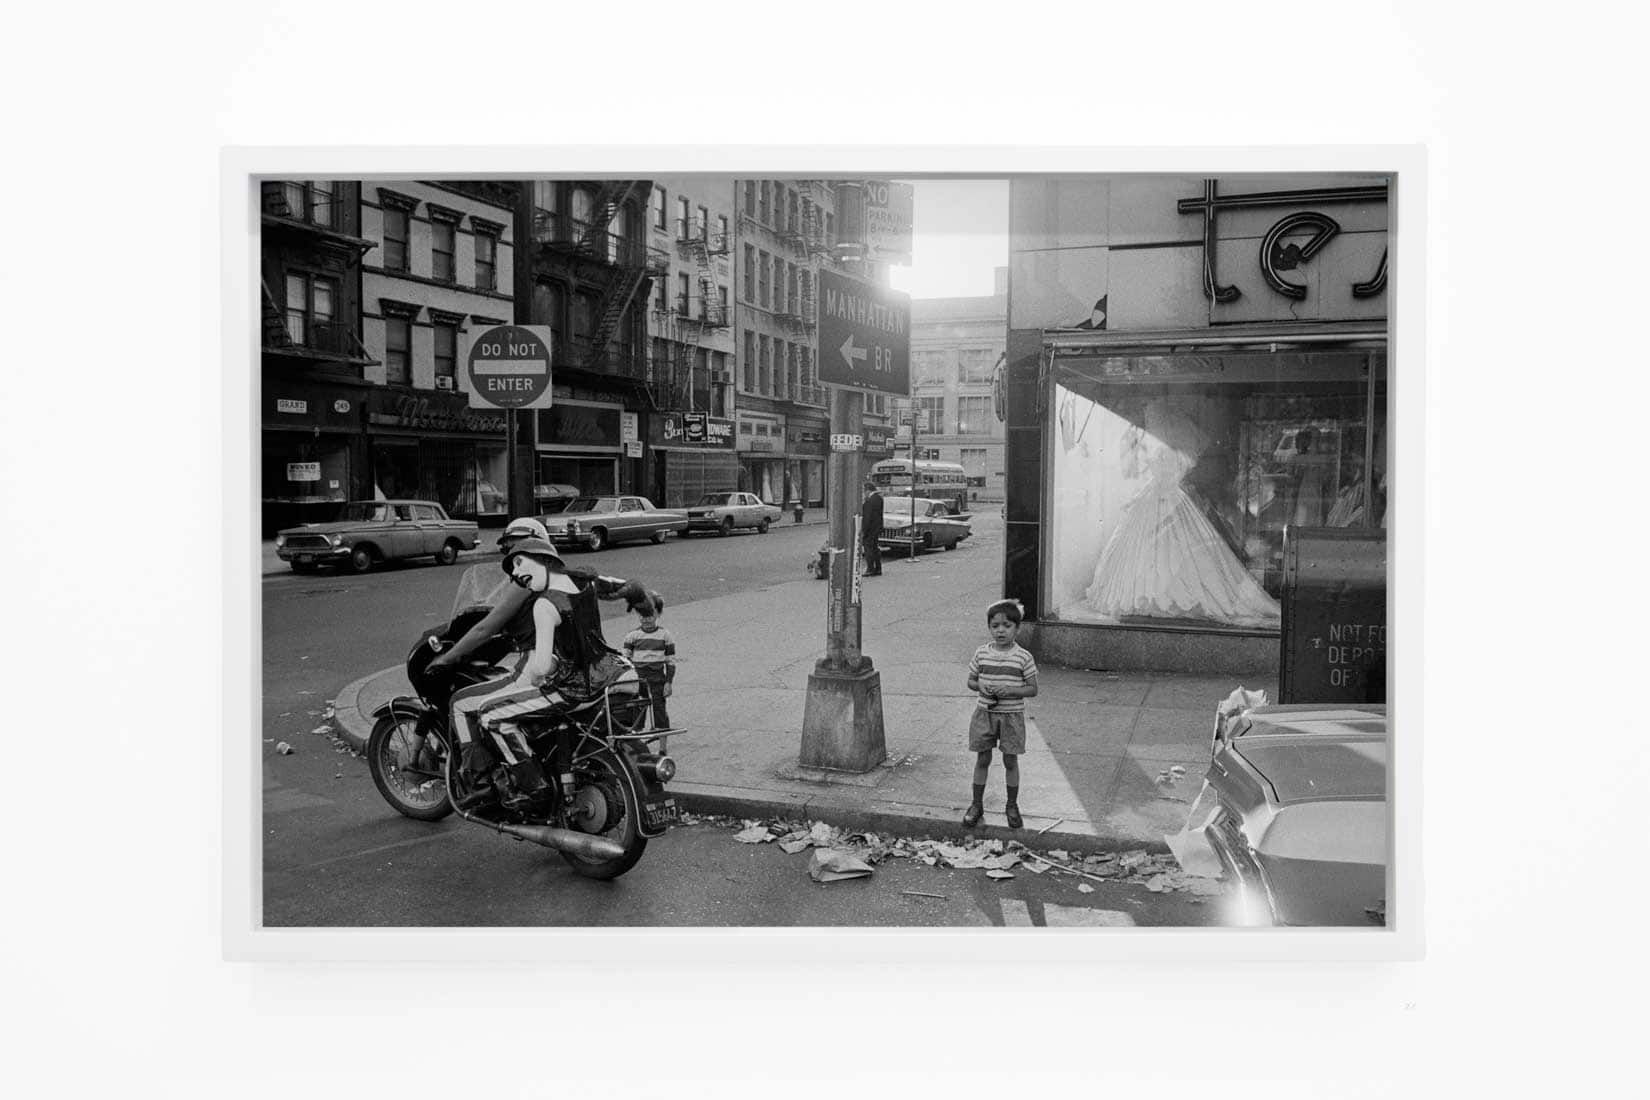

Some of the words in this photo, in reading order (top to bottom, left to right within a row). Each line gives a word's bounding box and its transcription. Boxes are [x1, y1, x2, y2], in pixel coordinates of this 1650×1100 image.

[867, 185, 888, 205] NO
[826, 289, 904, 334] MANHATTAN
[482, 343, 502, 357] DO
[508, 343, 537, 357] NOT
[875, 345, 892, 373] BR
[488, 378, 534, 392] ENTER
[279, 400, 305, 409] GRAND
[1329, 623, 1363, 642] NOT
[1330, 668, 1352, 687] OF
